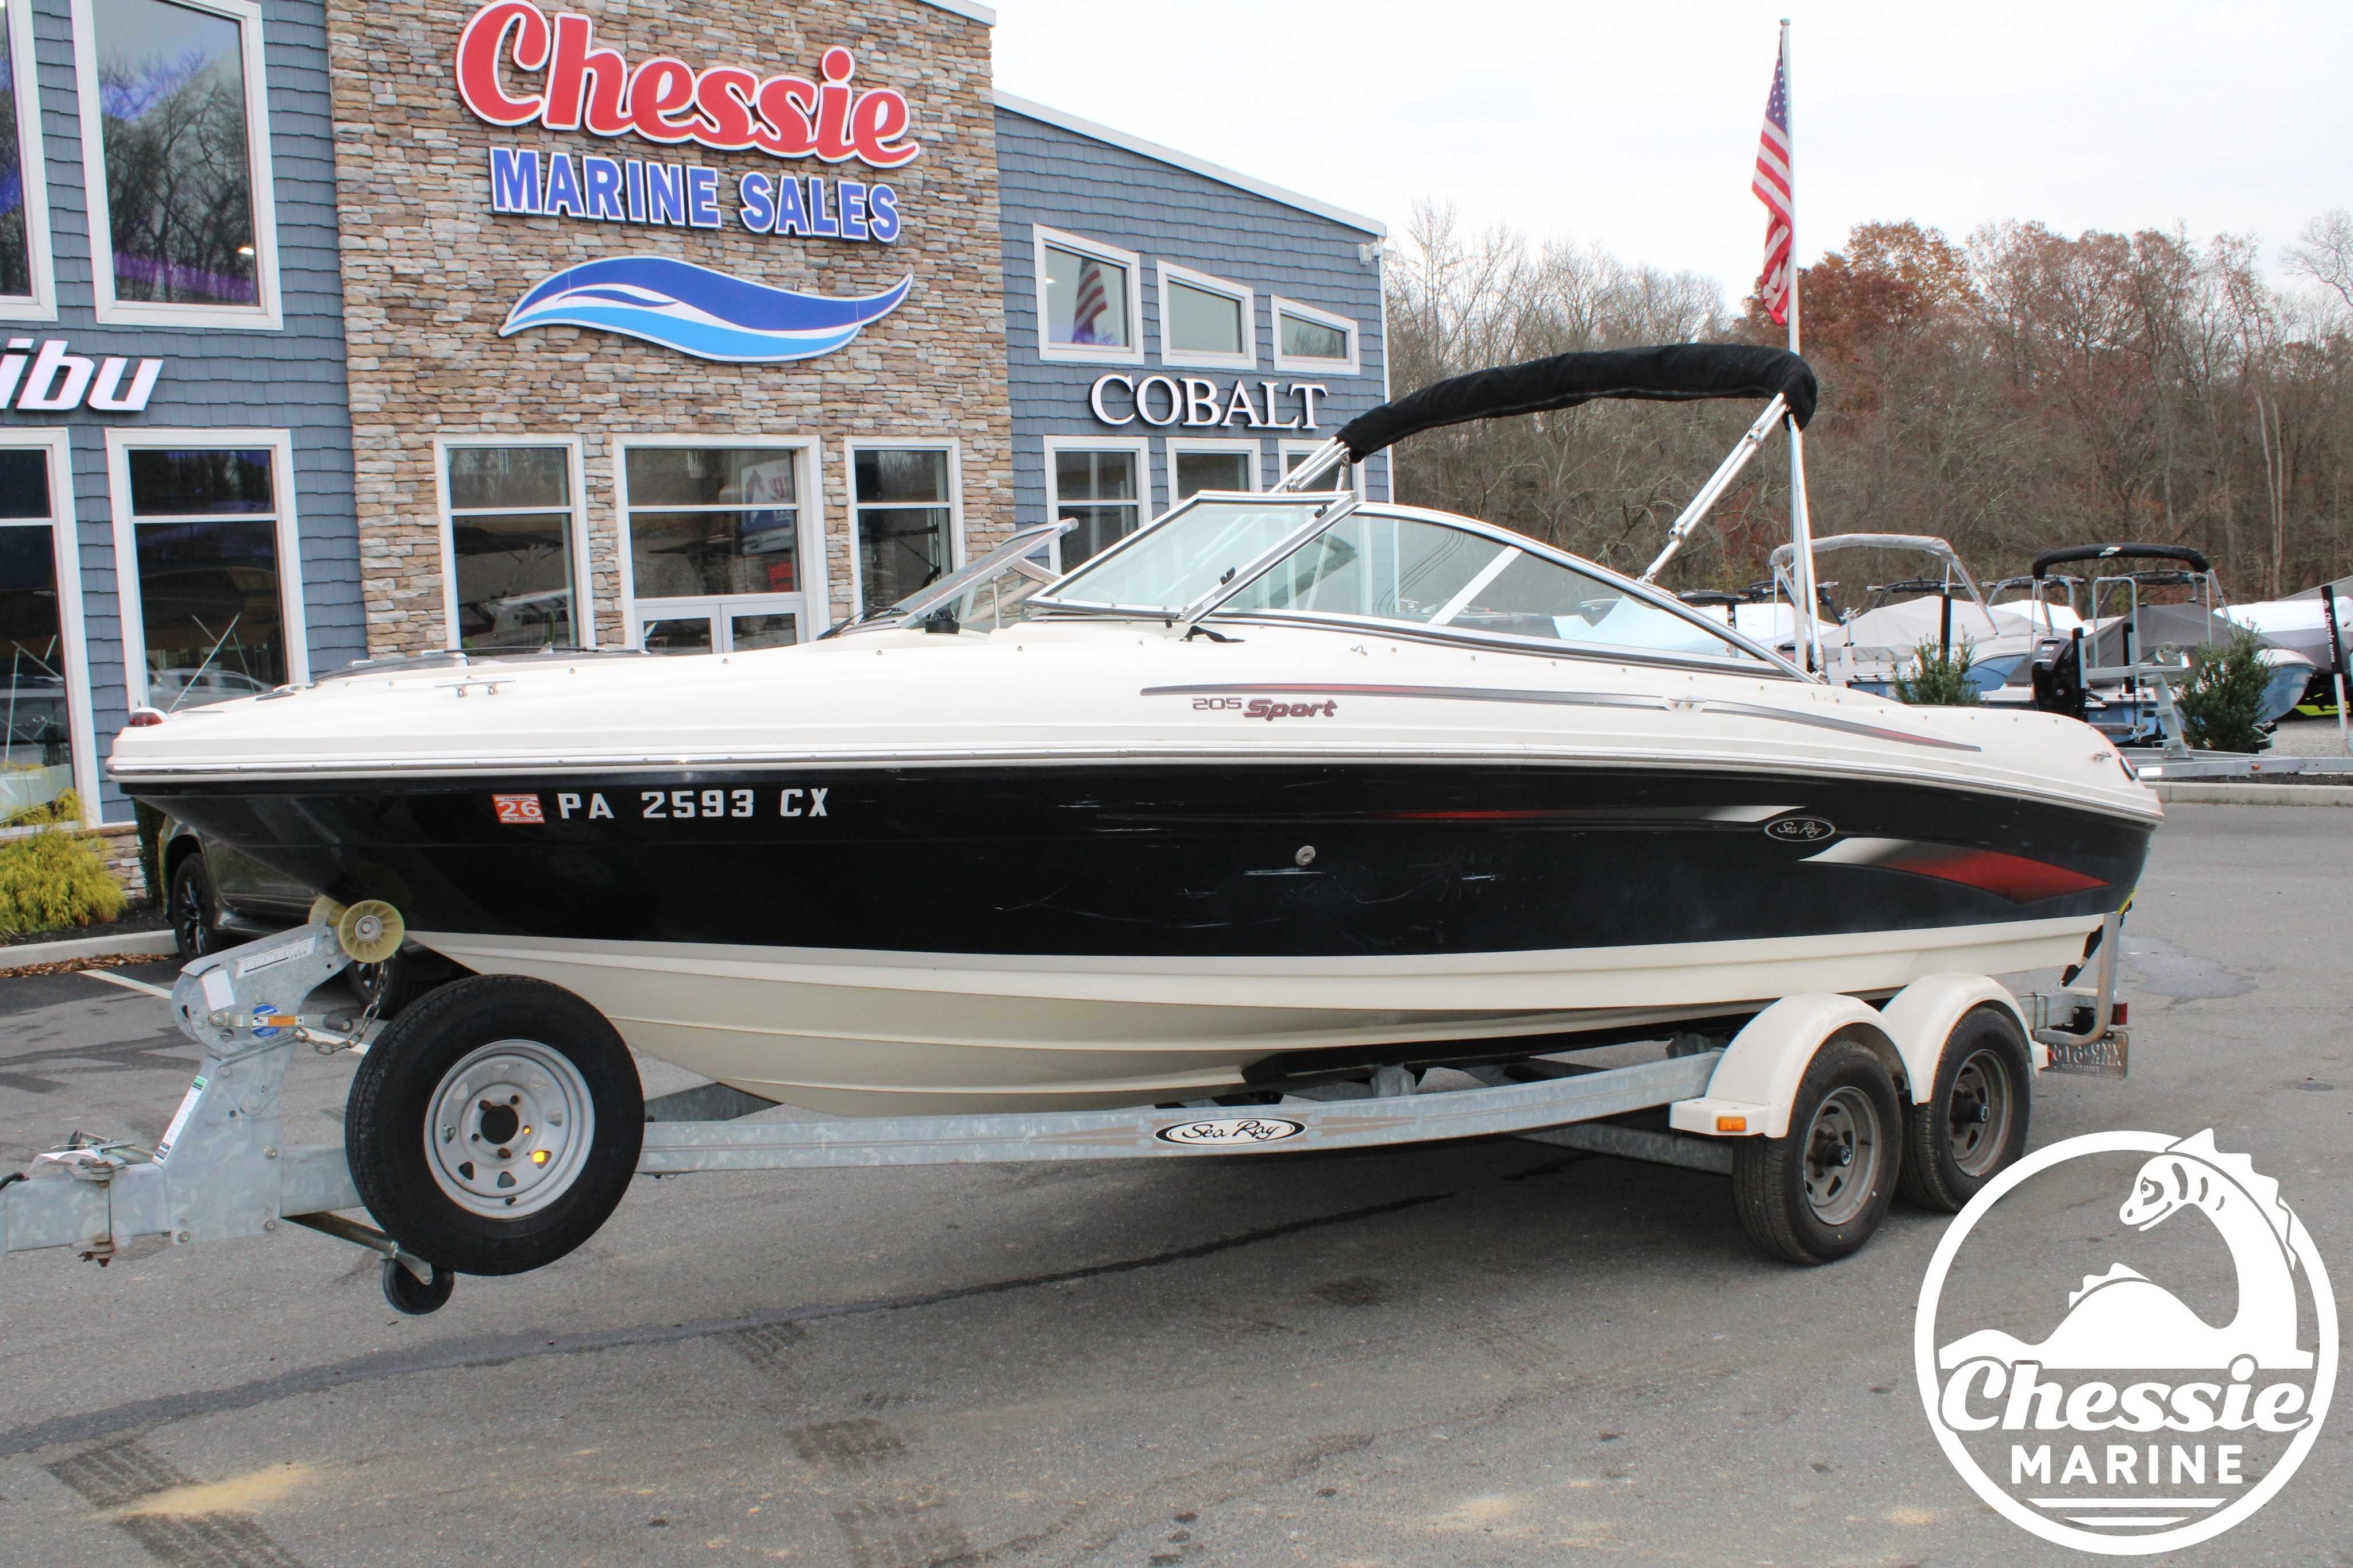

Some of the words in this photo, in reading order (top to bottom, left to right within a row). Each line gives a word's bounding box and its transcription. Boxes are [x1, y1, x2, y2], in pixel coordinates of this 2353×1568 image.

[455, 0, 919, 168] Chessie
[489, 146, 722, 229] MARINE
[739, 171, 902, 244] SALES
[1089, 374, 1328, 430] COBALT
[1191, 698, 1243, 710] 205
[1243, 698, 1338, 722] Sport
[497, 801, 541, 817] 26
[557, 793, 615, 819] PA
[641, 789, 754, 818] 2593
[780, 787, 828, 817] CX
[1777, 821, 1798, 834] Sea
[1798, 821, 1823, 838] Ray
[1181, 1123, 1229, 1138] Sea
[1232, 1120, 1281, 1140] Ray
